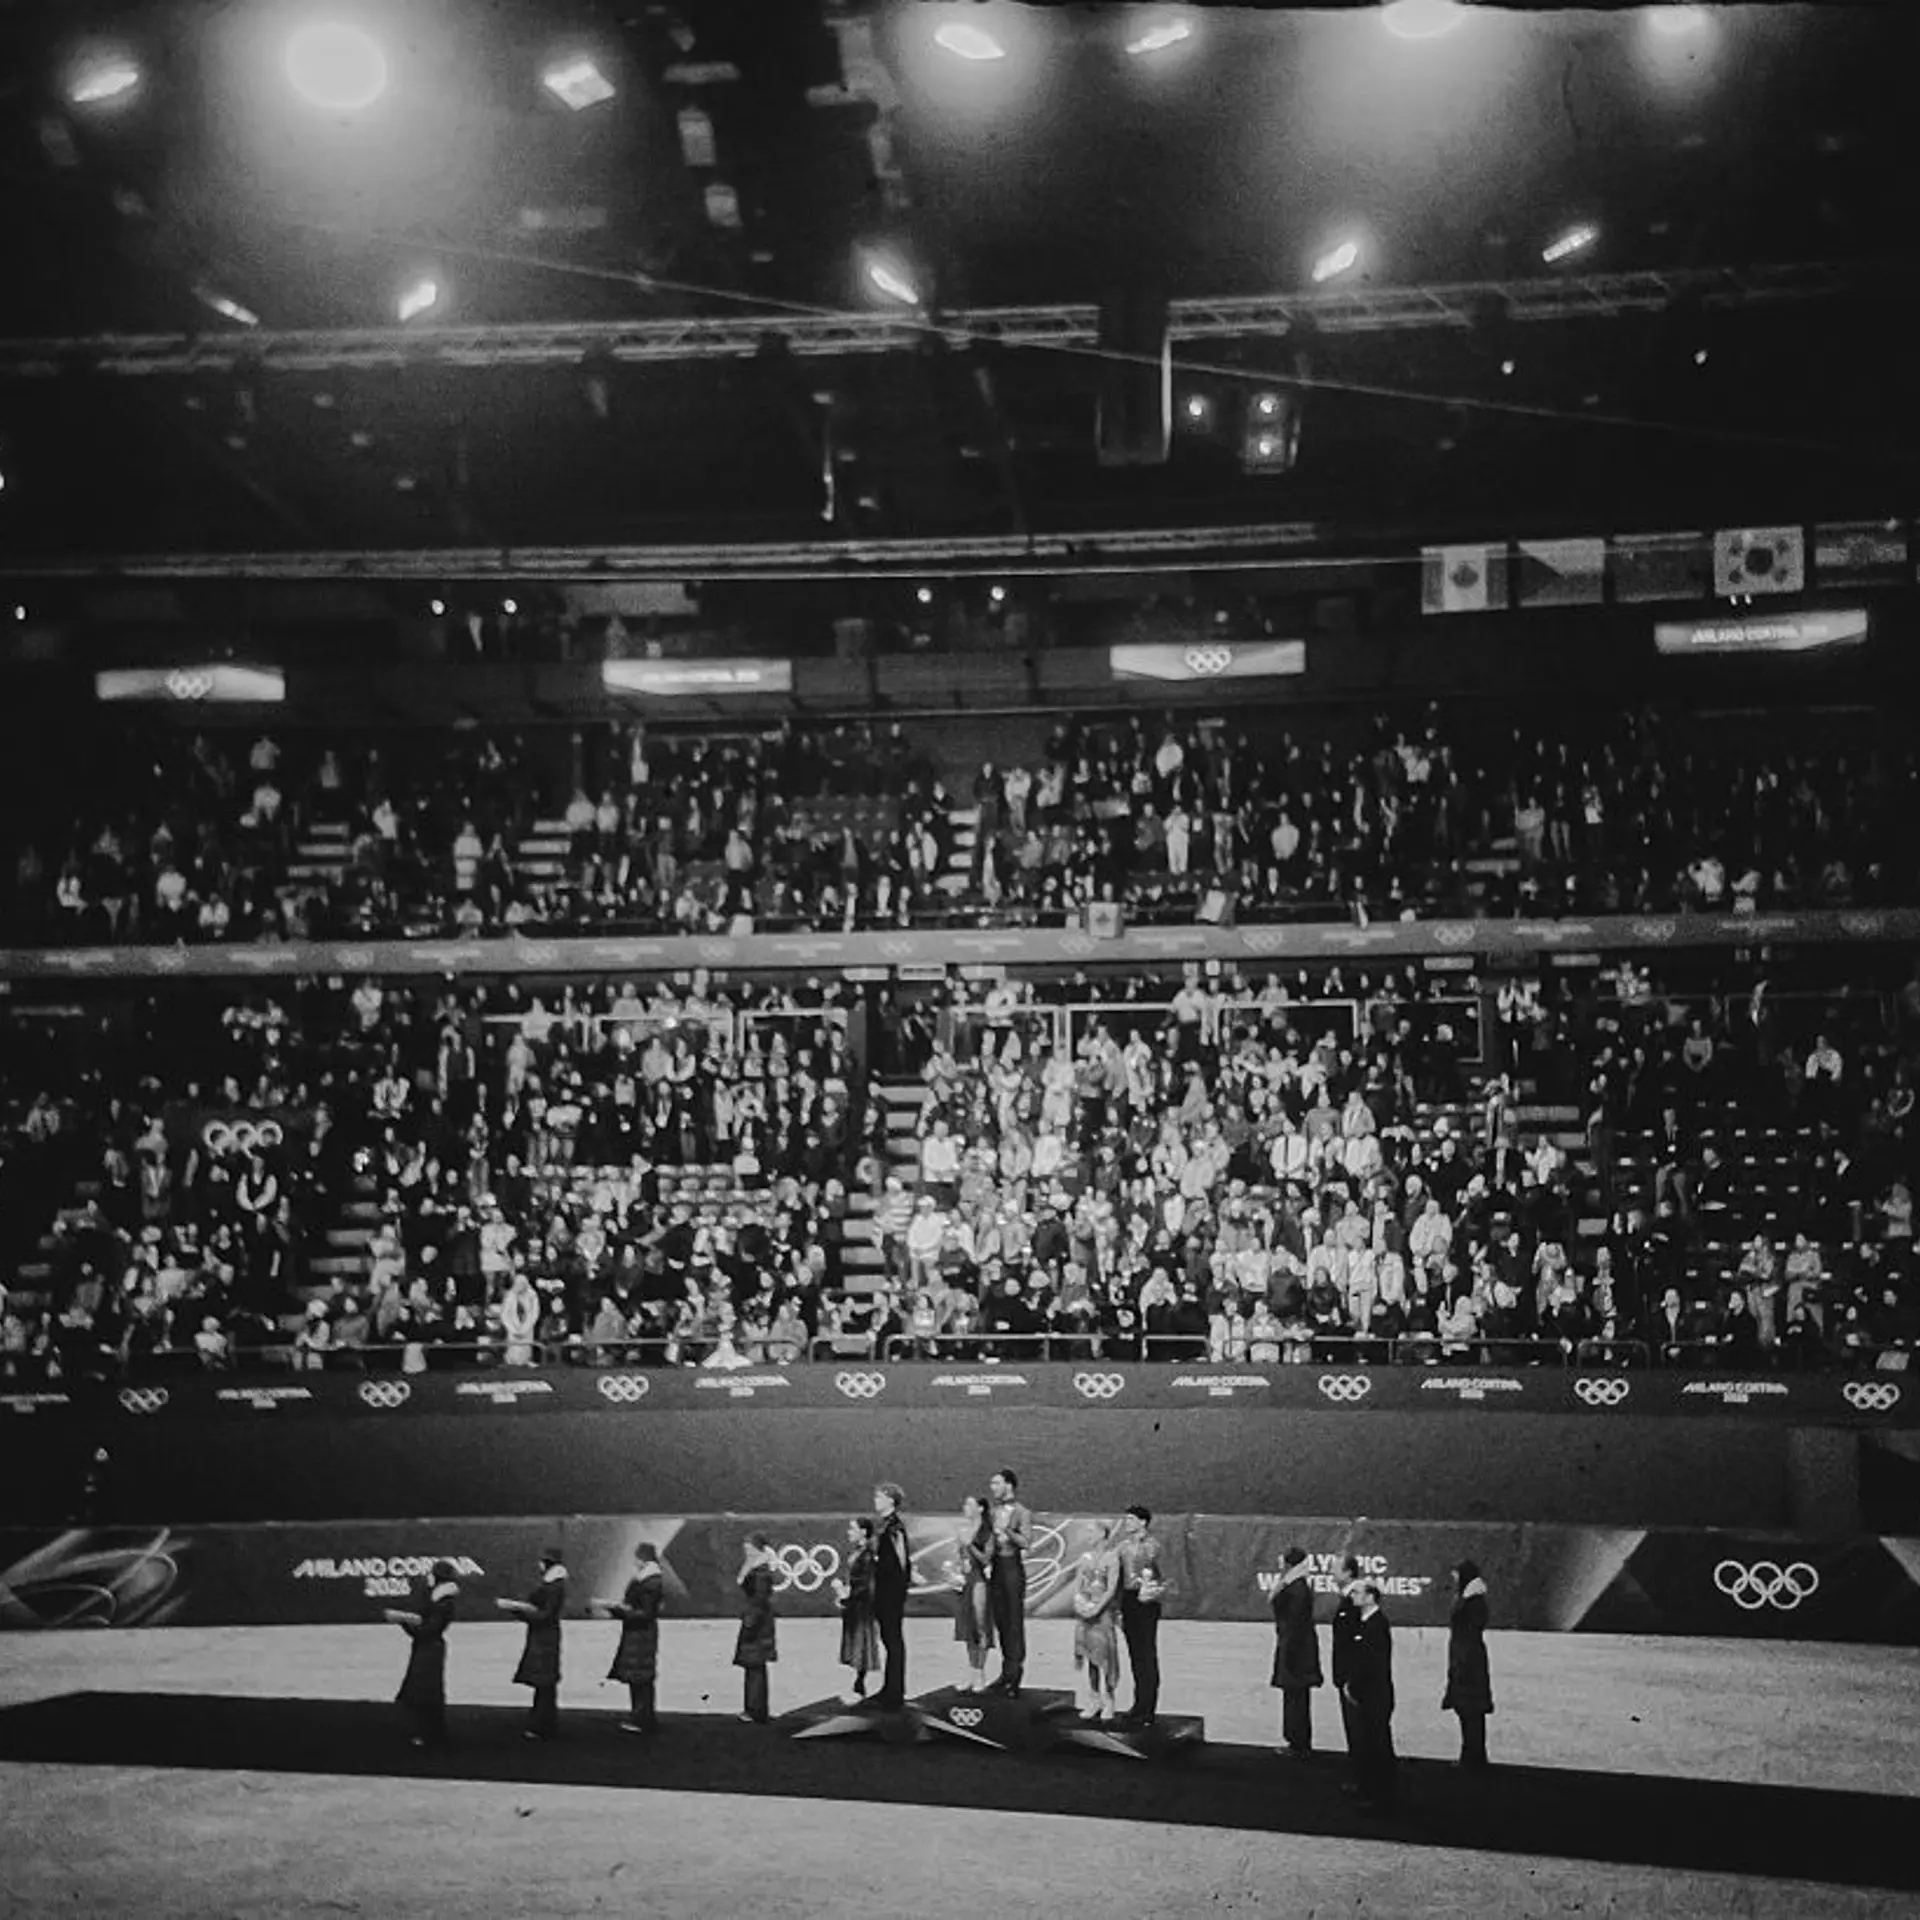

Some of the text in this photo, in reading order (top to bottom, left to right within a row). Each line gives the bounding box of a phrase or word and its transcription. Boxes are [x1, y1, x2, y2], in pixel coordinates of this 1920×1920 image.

[293, 1556, 484, 1578] MILANO CORNA
[364, 1577, 410, 1597] 2026
